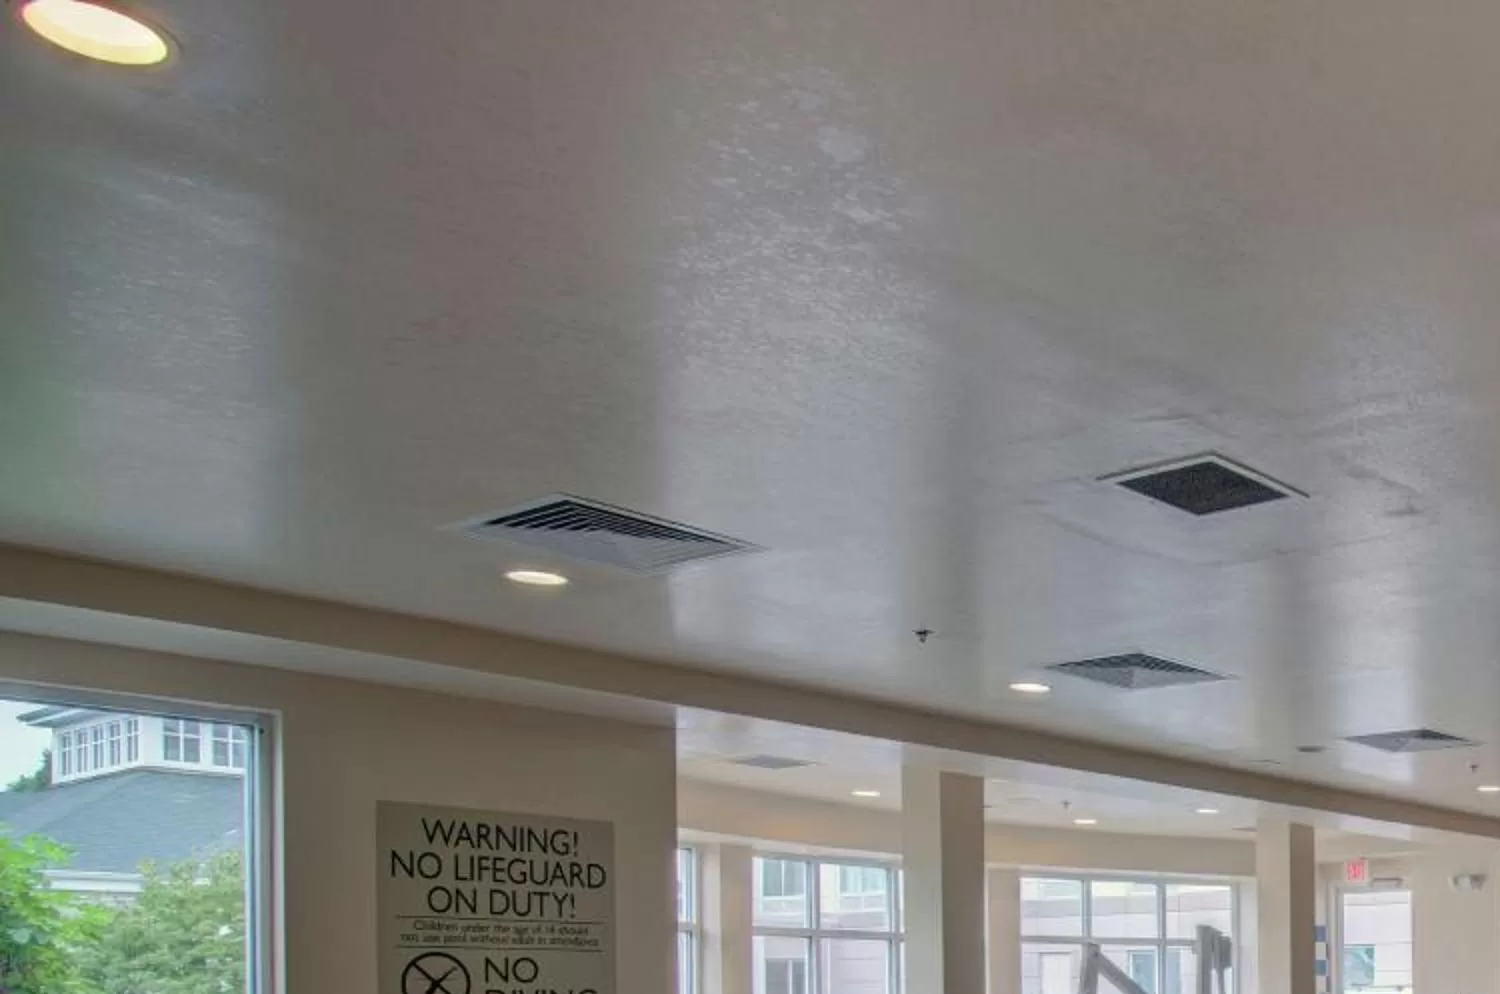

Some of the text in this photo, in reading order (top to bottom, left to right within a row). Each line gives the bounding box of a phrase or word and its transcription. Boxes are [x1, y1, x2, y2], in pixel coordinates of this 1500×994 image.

[421, 817, 579, 858] WARNING!
[391, 849, 607, 889] NO LIFEGUARD
[427, 885, 577, 919] ON DUTY!
[484, 956, 540, 984] NO
